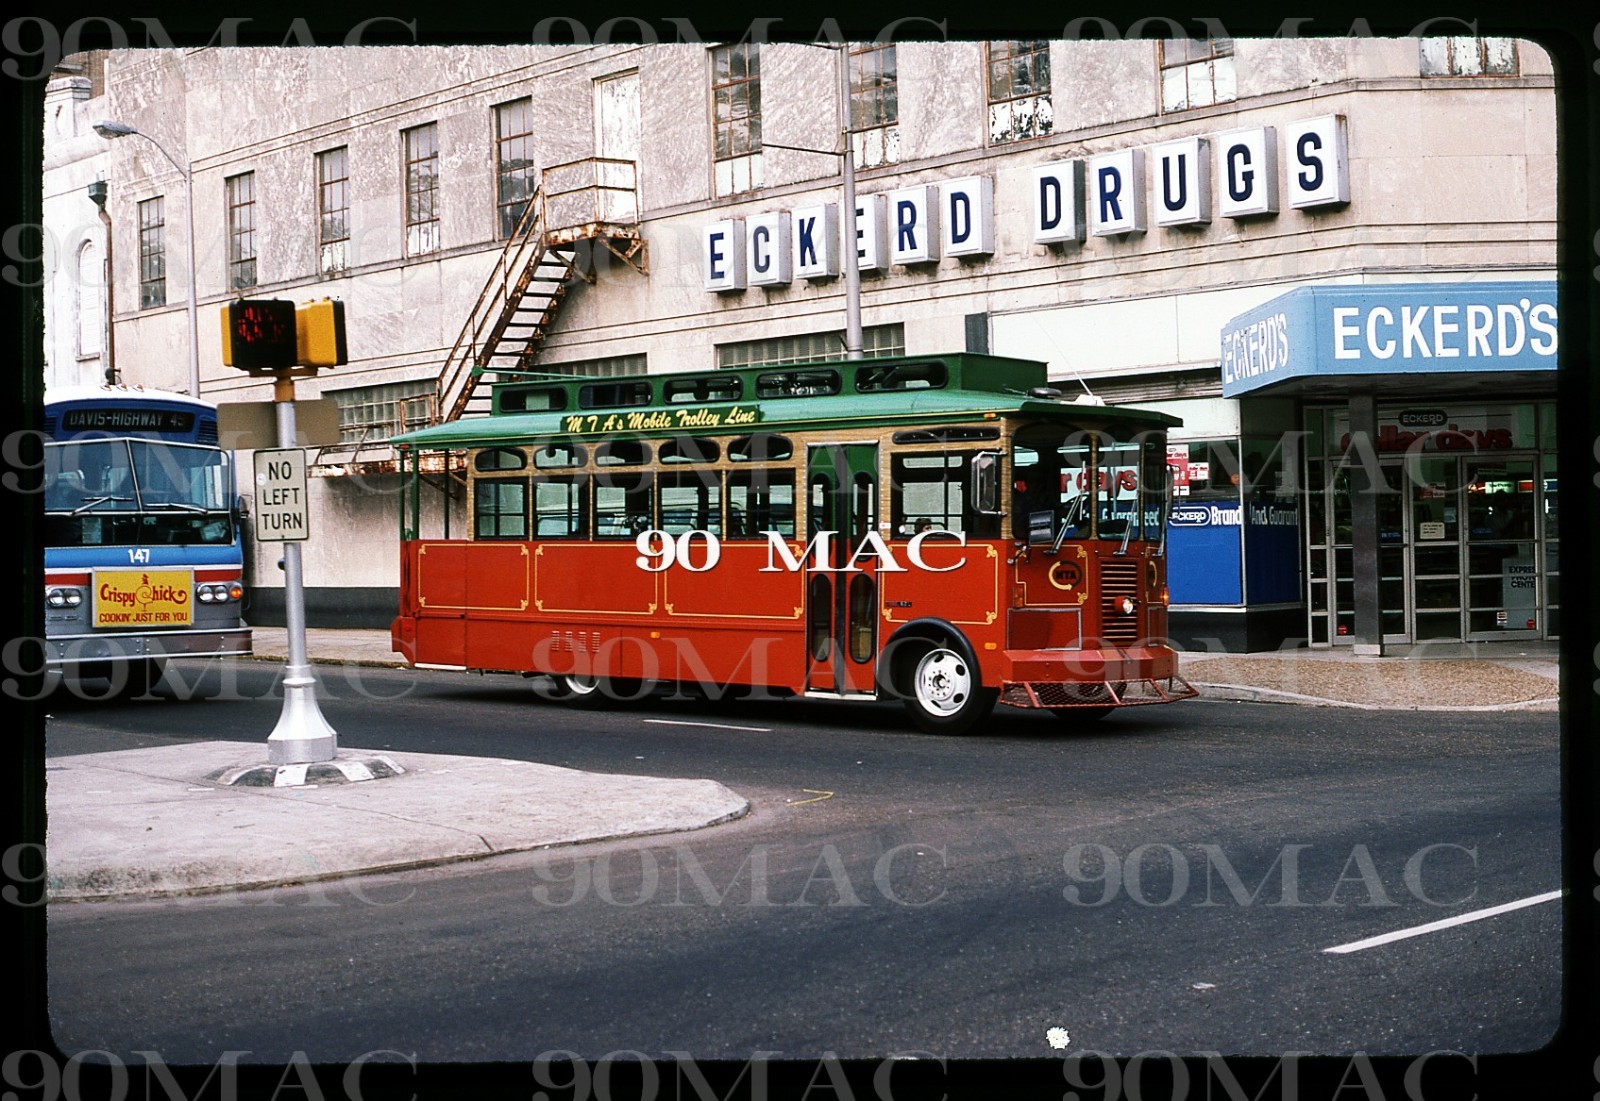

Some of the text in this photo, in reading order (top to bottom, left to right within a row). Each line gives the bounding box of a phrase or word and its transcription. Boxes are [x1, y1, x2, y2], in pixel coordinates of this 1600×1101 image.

[709, 132, 1324, 280] ECKERD DRUGS
[1333, 298, 1558, 359] ECKERD'S
[1223, 313, 1289, 384] ECKERD'S
[69, 411, 163, 426] DAVIS-HIGHWAY
[566, 416, 583, 433] M
[587, 414, 598, 432] T
[627, 411, 671, 430] Mobile
[676, 409, 720, 427] Trolley
[724, 406, 756, 424] Line
[1402, 413, 1444, 425] ECKERD
[268, 461, 292, 480] NO
[263, 488, 300, 505] LEFT
[261, 513, 302, 530] TURN
[1211, 506, 1241, 525] Brand
[128, 549, 150, 563] 147
[1056, 570, 1077, 580] MTA
[100, 583, 187, 607] Crispy Chick
[100, 612, 188, 622] COOKIN' JUST FOR YOU
